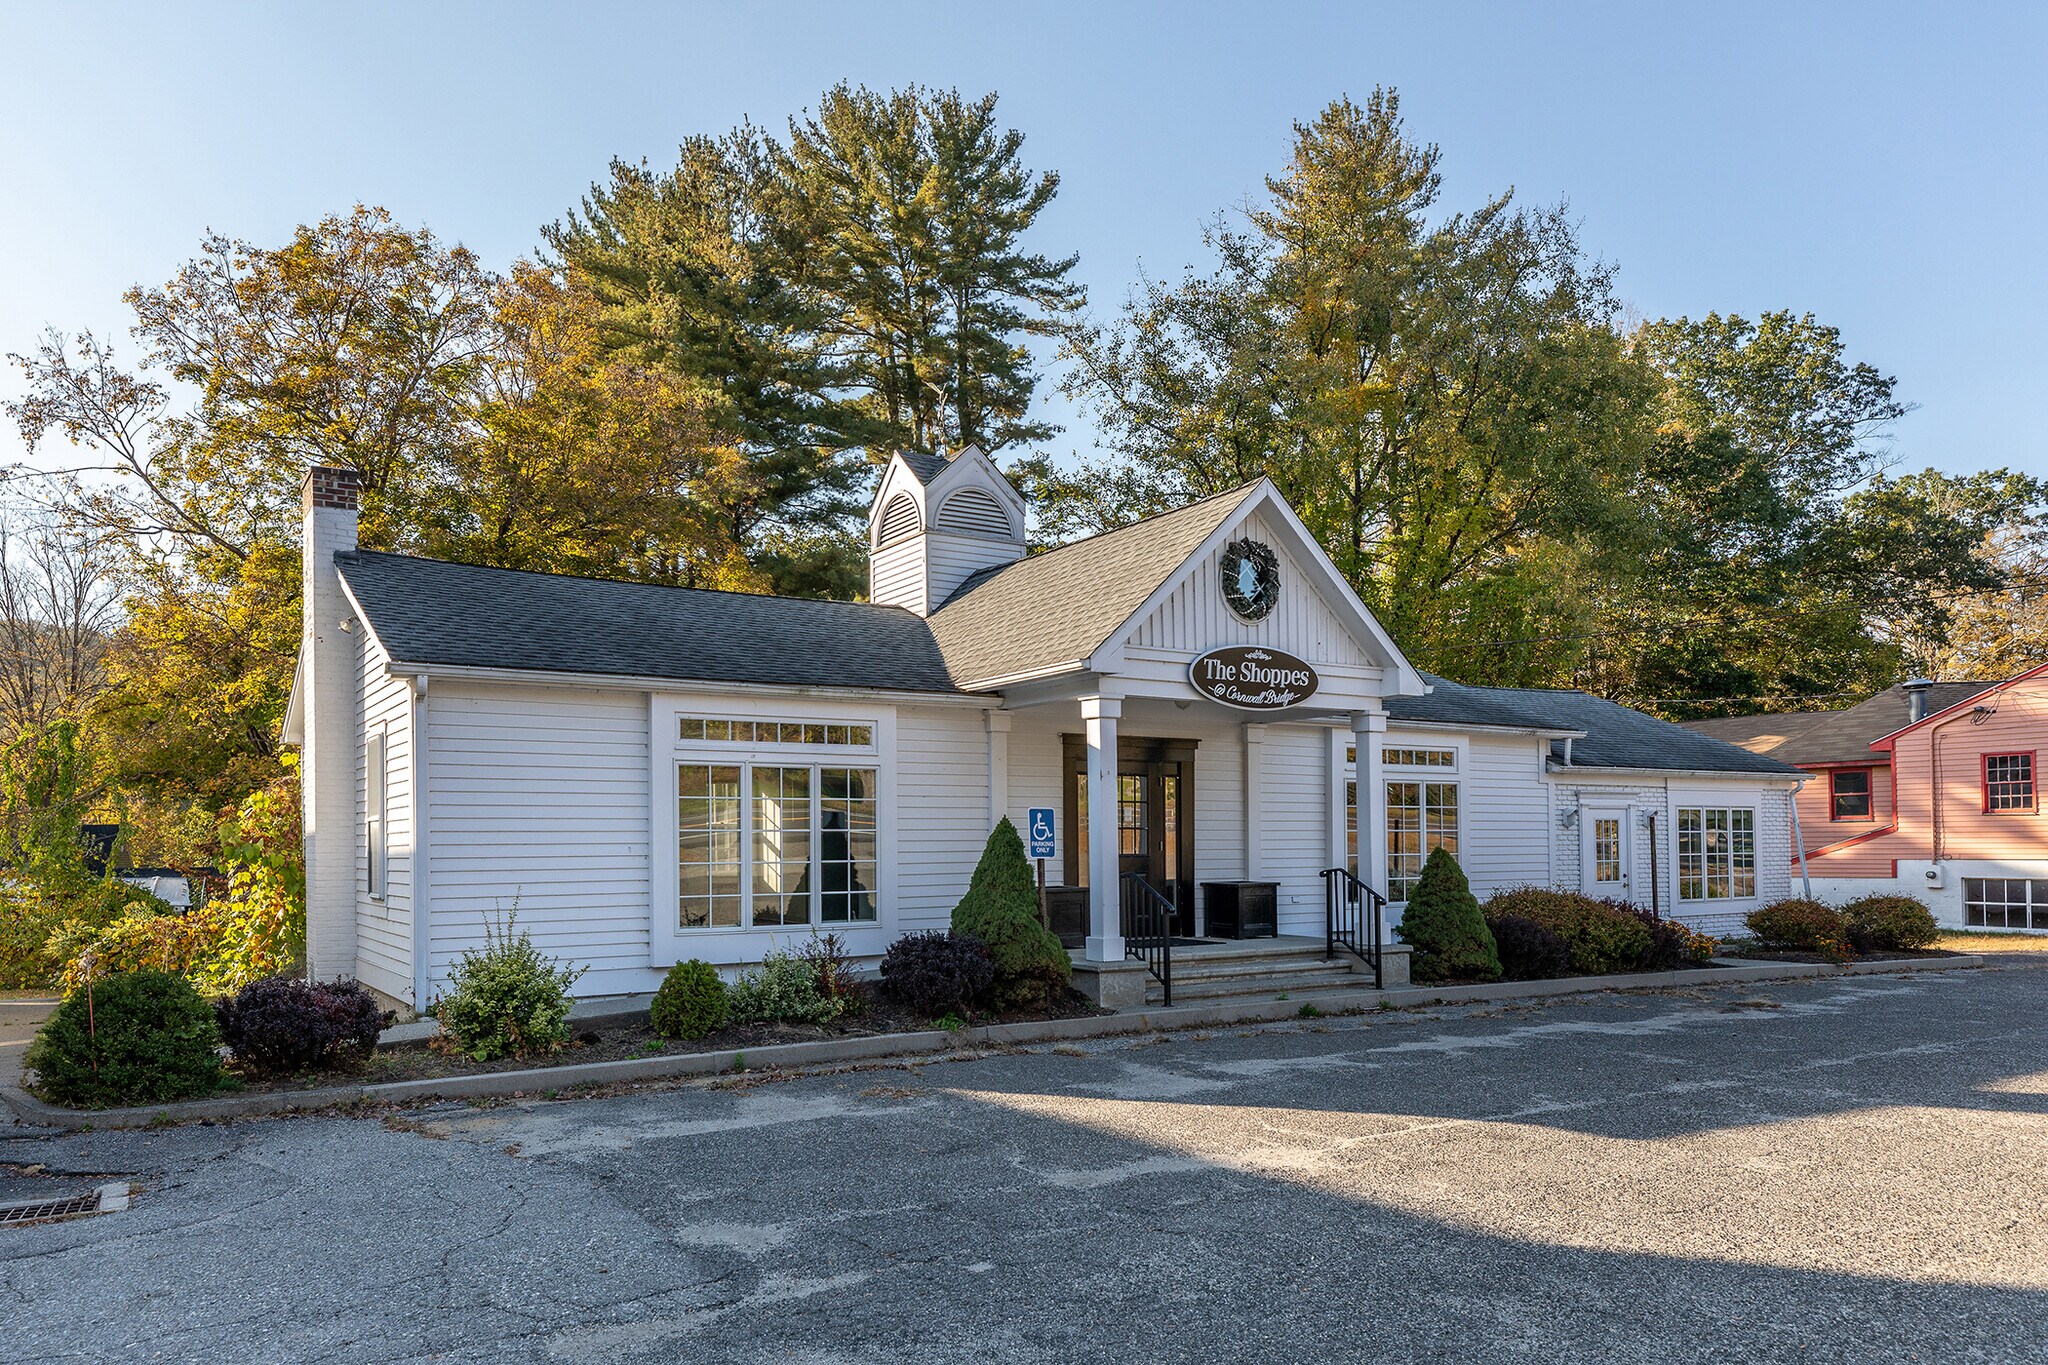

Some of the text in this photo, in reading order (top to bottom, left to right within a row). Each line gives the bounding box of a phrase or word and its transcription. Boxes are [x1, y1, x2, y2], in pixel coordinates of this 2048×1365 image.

[1204, 658, 1309, 688] The Shoppes
[1227, 686, 1265, 704] Cornwall
[1265, 689, 1296, 706] Bridge
